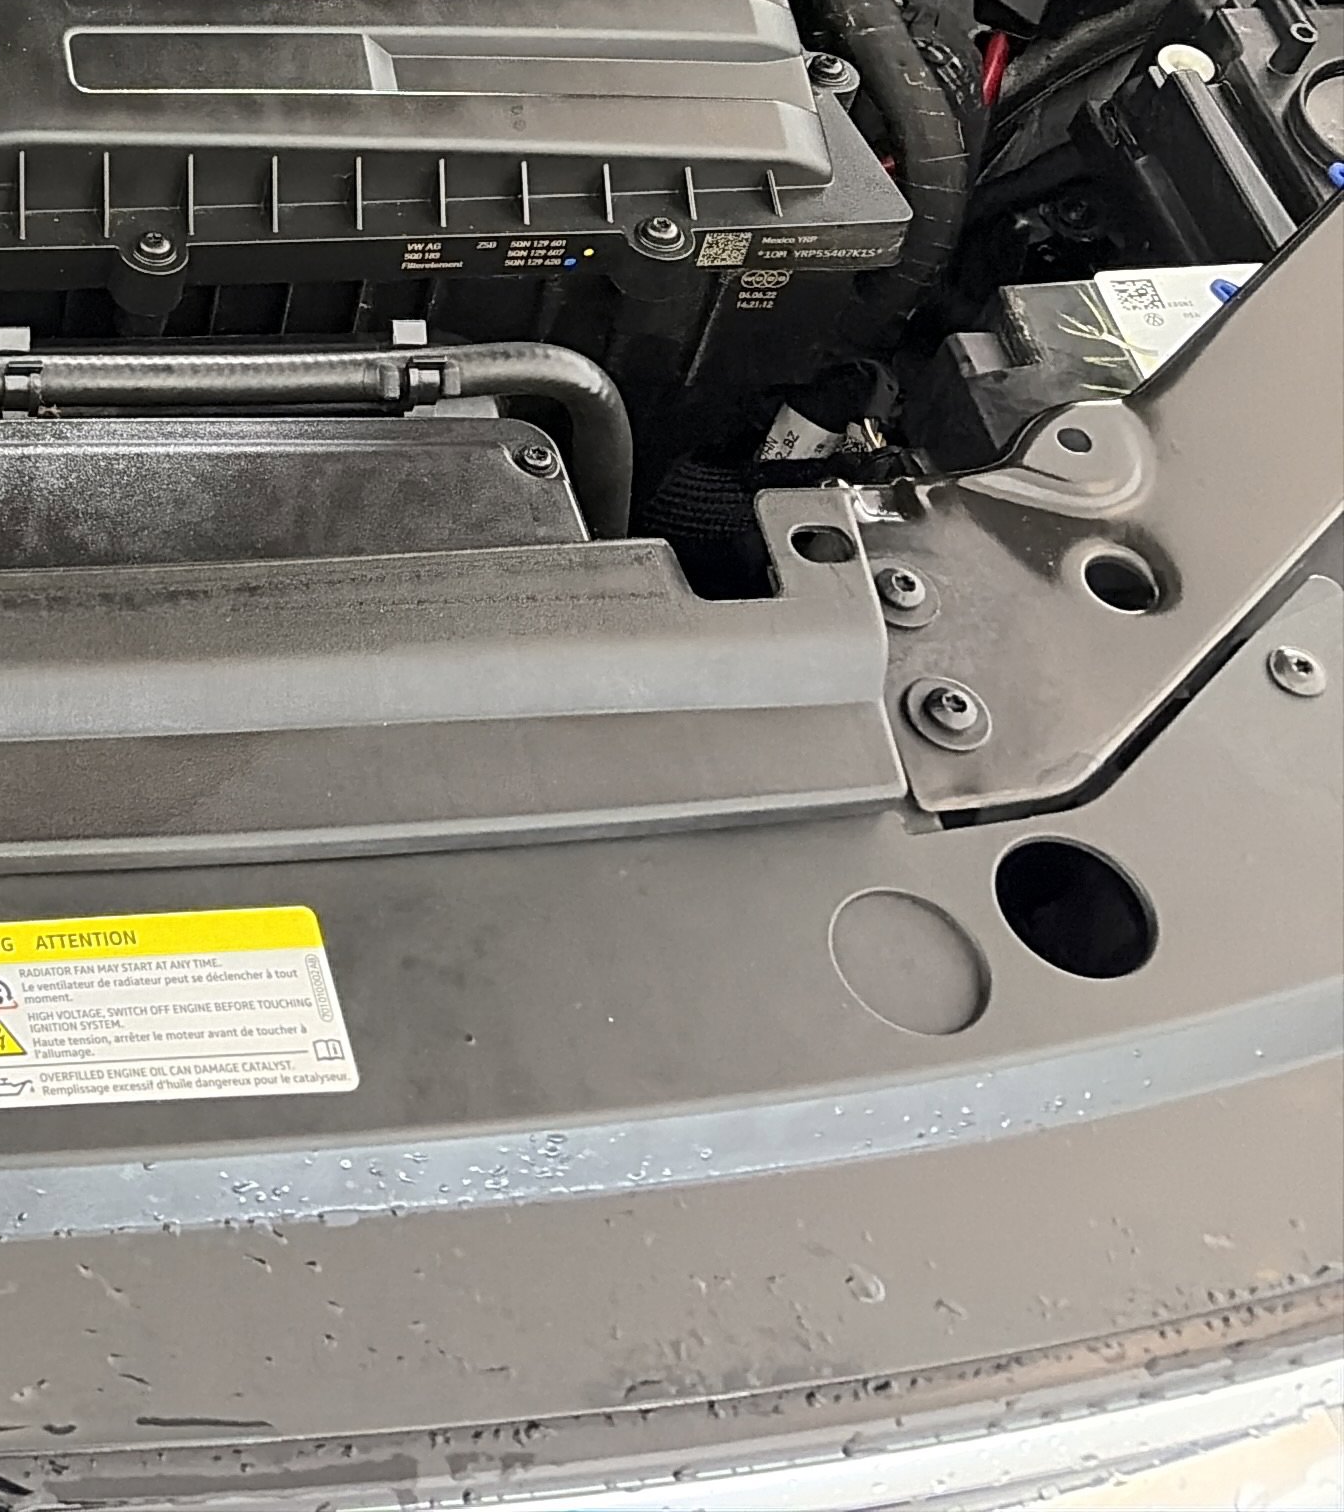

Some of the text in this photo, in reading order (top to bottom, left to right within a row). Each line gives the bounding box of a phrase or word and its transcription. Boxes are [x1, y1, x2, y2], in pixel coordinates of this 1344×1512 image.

[36, 930, 137, 950] ATTENTION
[19, 966, 72, 978] RADIATOR
[74, 965, 95, 976] FAN
[97, 963, 119, 974] MAY
[121, 961, 153, 973] START
[155, 961, 167, 971] AT
[170, 960, 191, 970] ANY
[27, 1011, 54, 1022] HIGH
[107, 1005, 148, 1018] SWITCH
[150, 1004, 171, 1015] OFF
[173, 1002, 213, 1014] ENGINE
[214, 1000, 256, 1012] BEFORE
[257, 997, 312, 1010] TOUCHING
[29, 1021, 78, 1033] IGNITION
[39, 1070, 104, 1083] OVERFILLED
[107, 1068, 147, 1079] ENGINE
[149, 1066, 167, 1077] OIL
[169, 1065, 192, 1076] CAN
[194, 1062, 240, 1075] DAMAGE
